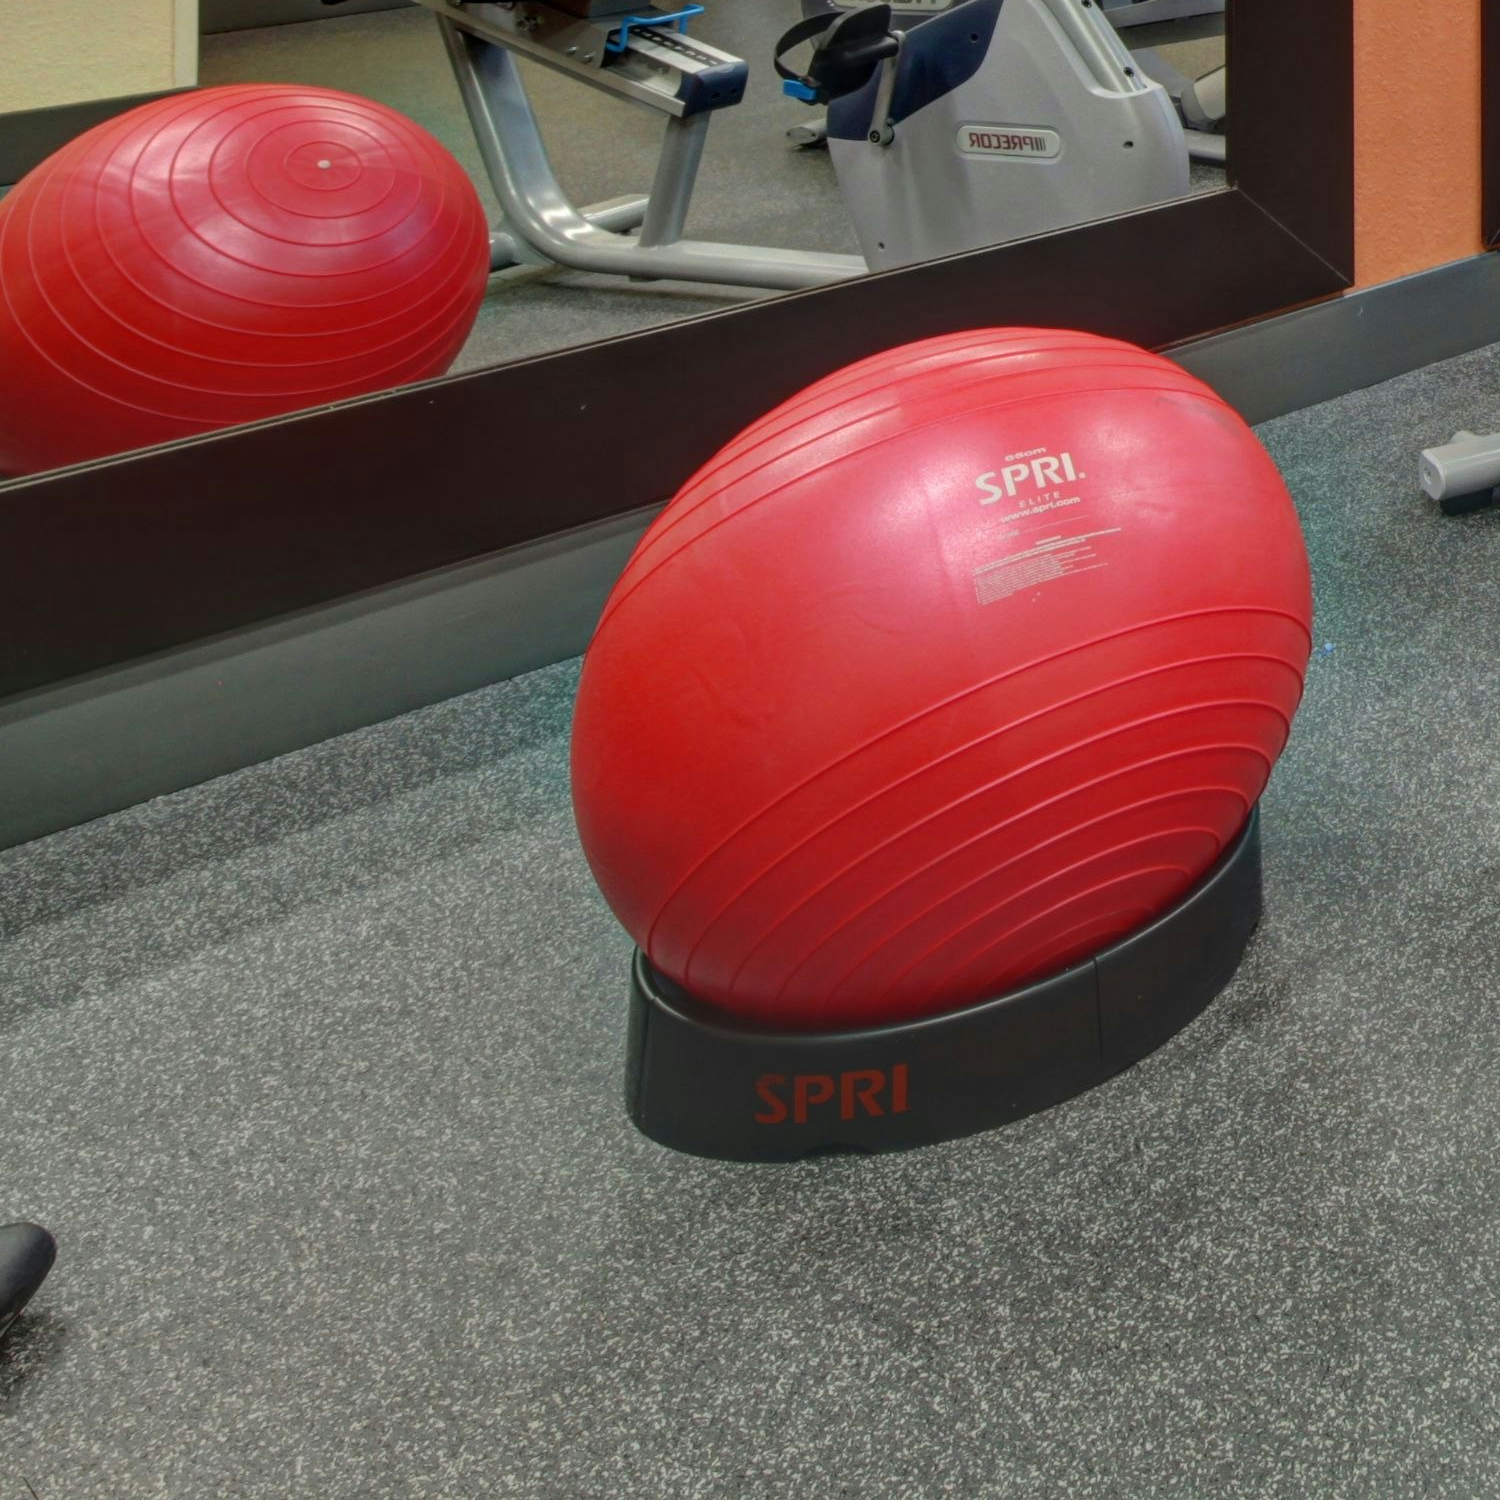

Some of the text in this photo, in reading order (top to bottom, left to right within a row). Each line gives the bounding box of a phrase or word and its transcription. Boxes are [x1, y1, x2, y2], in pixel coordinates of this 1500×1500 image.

[1000, 496, 1081, 523] www.spri.com
[1019, 491, 1061, 508] ELITE
[754, 1064, 909, 1124] SPRI
